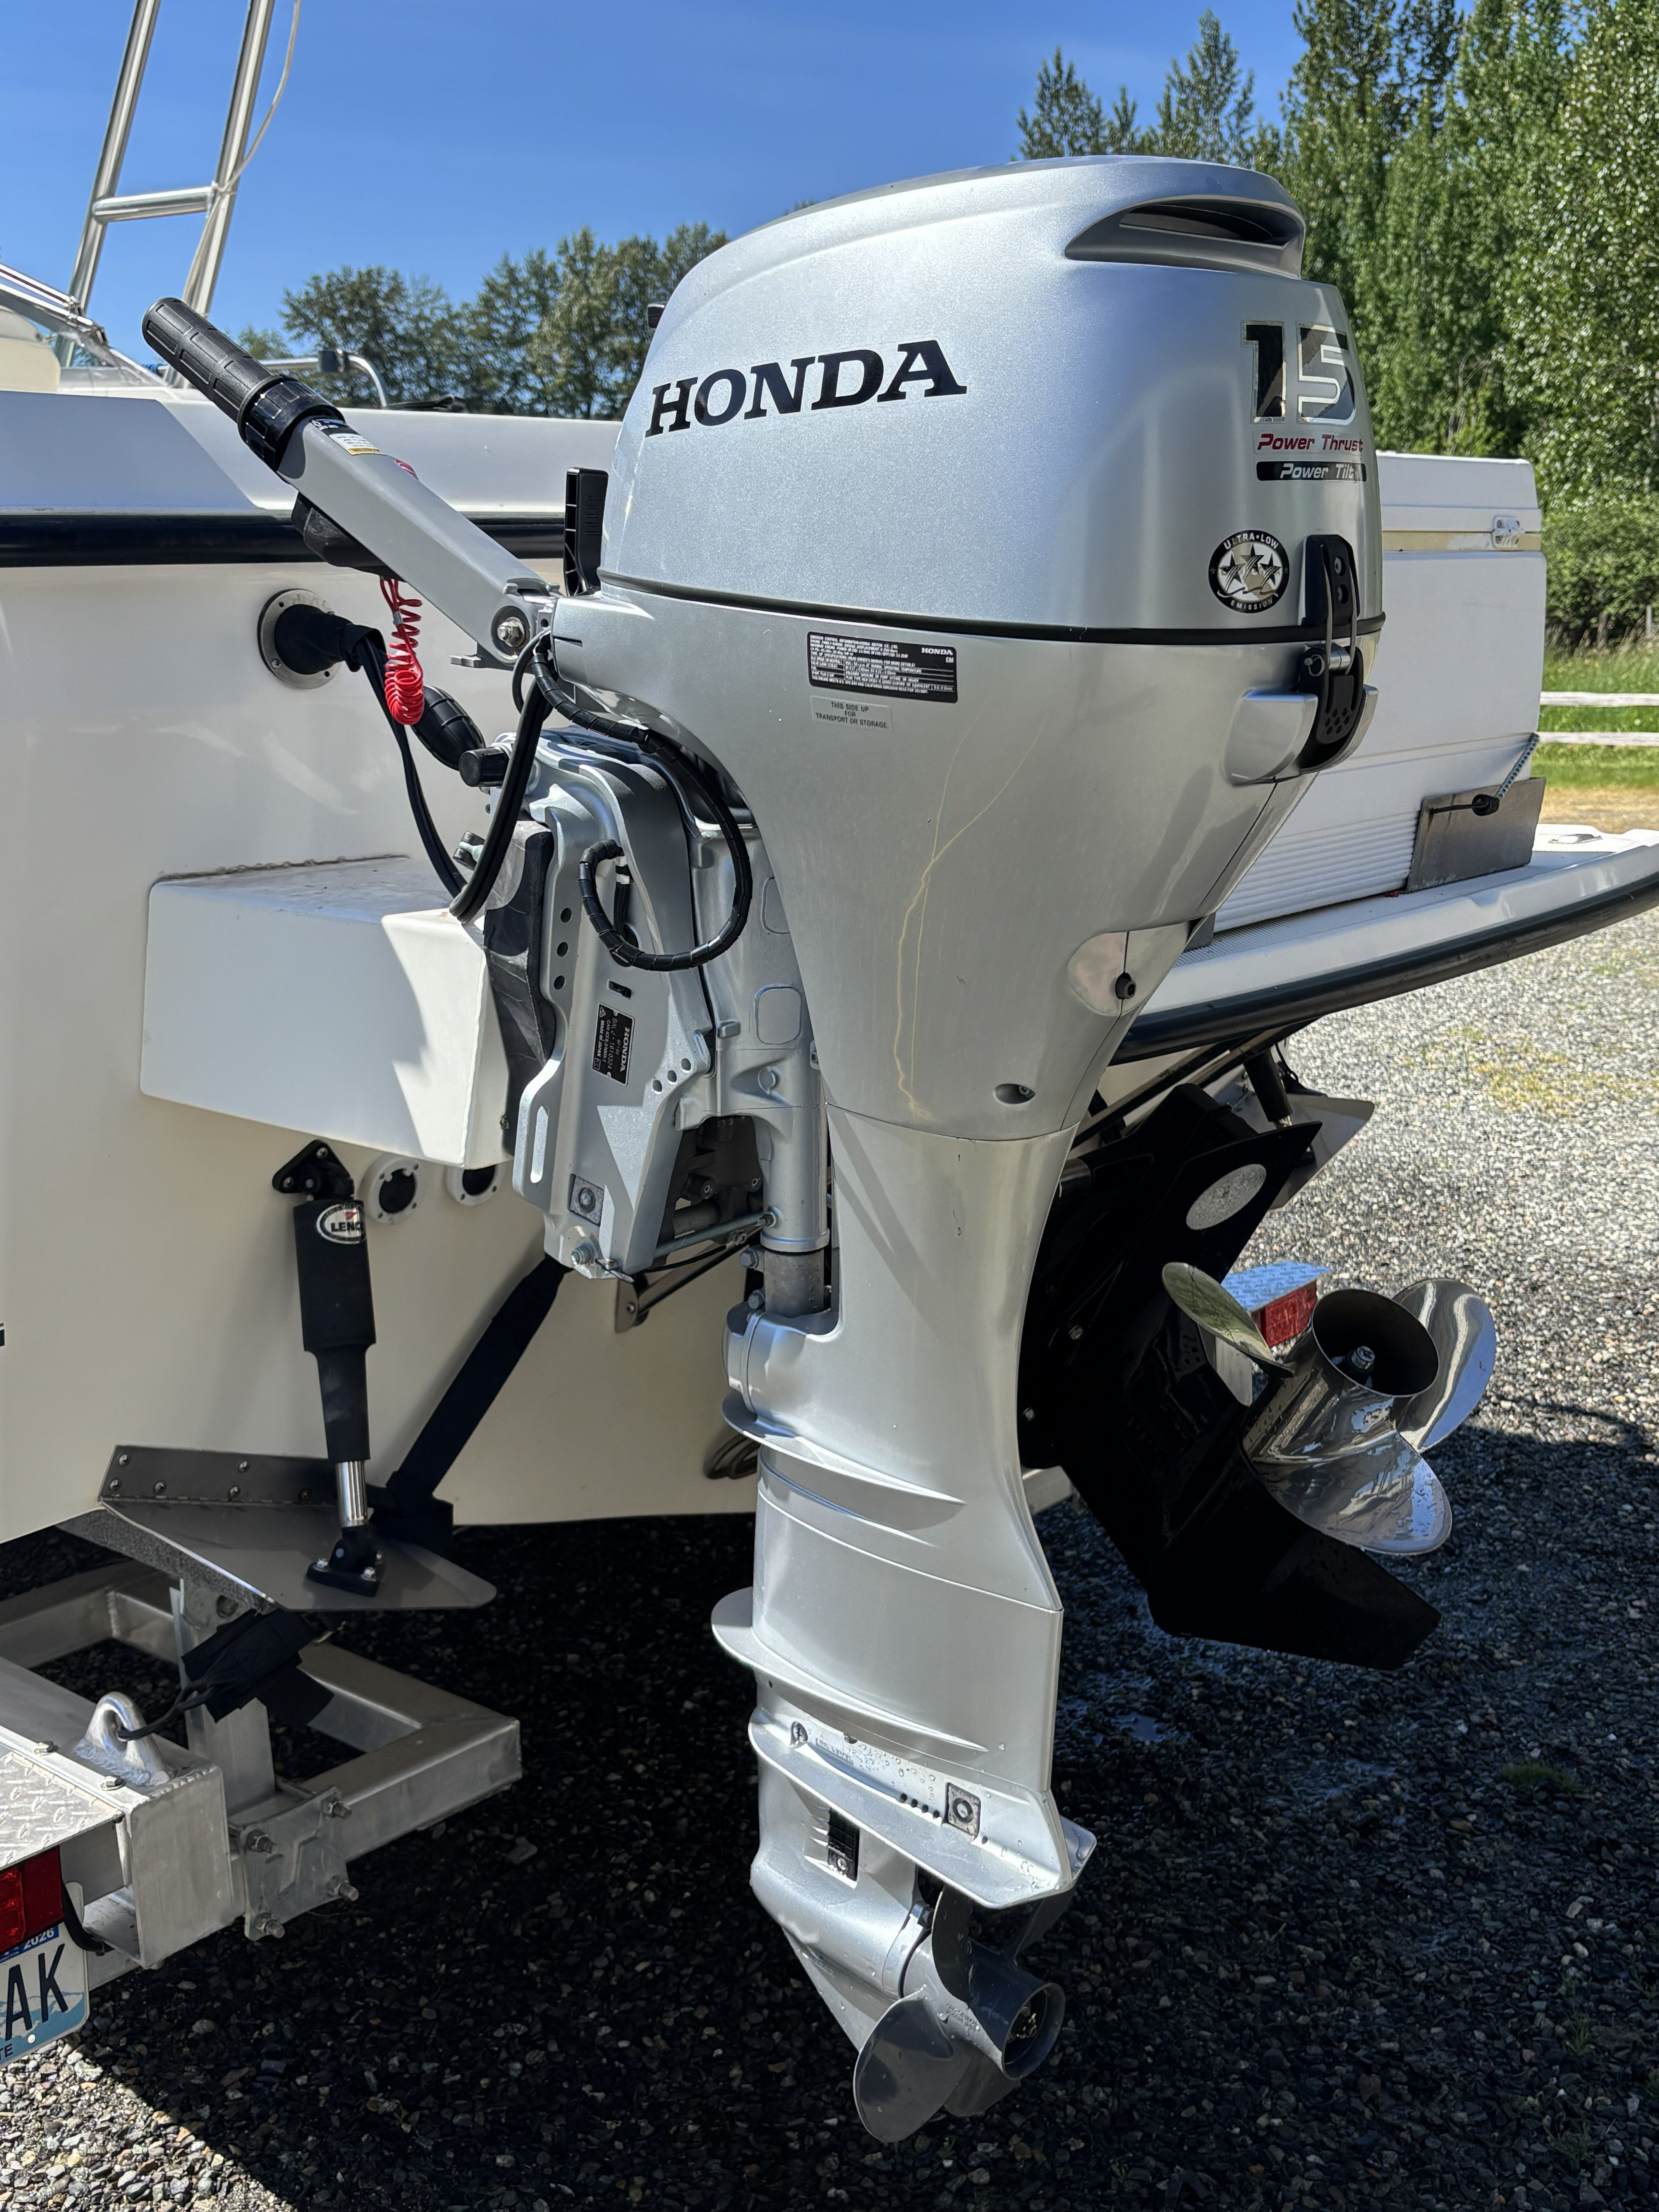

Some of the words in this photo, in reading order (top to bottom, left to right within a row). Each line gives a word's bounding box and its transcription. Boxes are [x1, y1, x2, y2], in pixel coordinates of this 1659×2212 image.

[1242, 320, 1356, 425] 15
[645, 340, 967, 438] HONDA
[1257, 433, 1315, 451] Power
[1321, 434, 1363, 452] Thrust
[1280, 463, 1329, 479] Power
[1336, 464, 1355, 479] Tilt
[1231, 597, 1273, 610] EMISSION
[921, 647, 953, 655] HONDA
[816, 713, 848, 723] TRANSPORT
[860, 719, 889, 729] STORAGE.
[620, 1027, 630, 1072] HONDA
[23, 1927, 55, 1950] 2026
